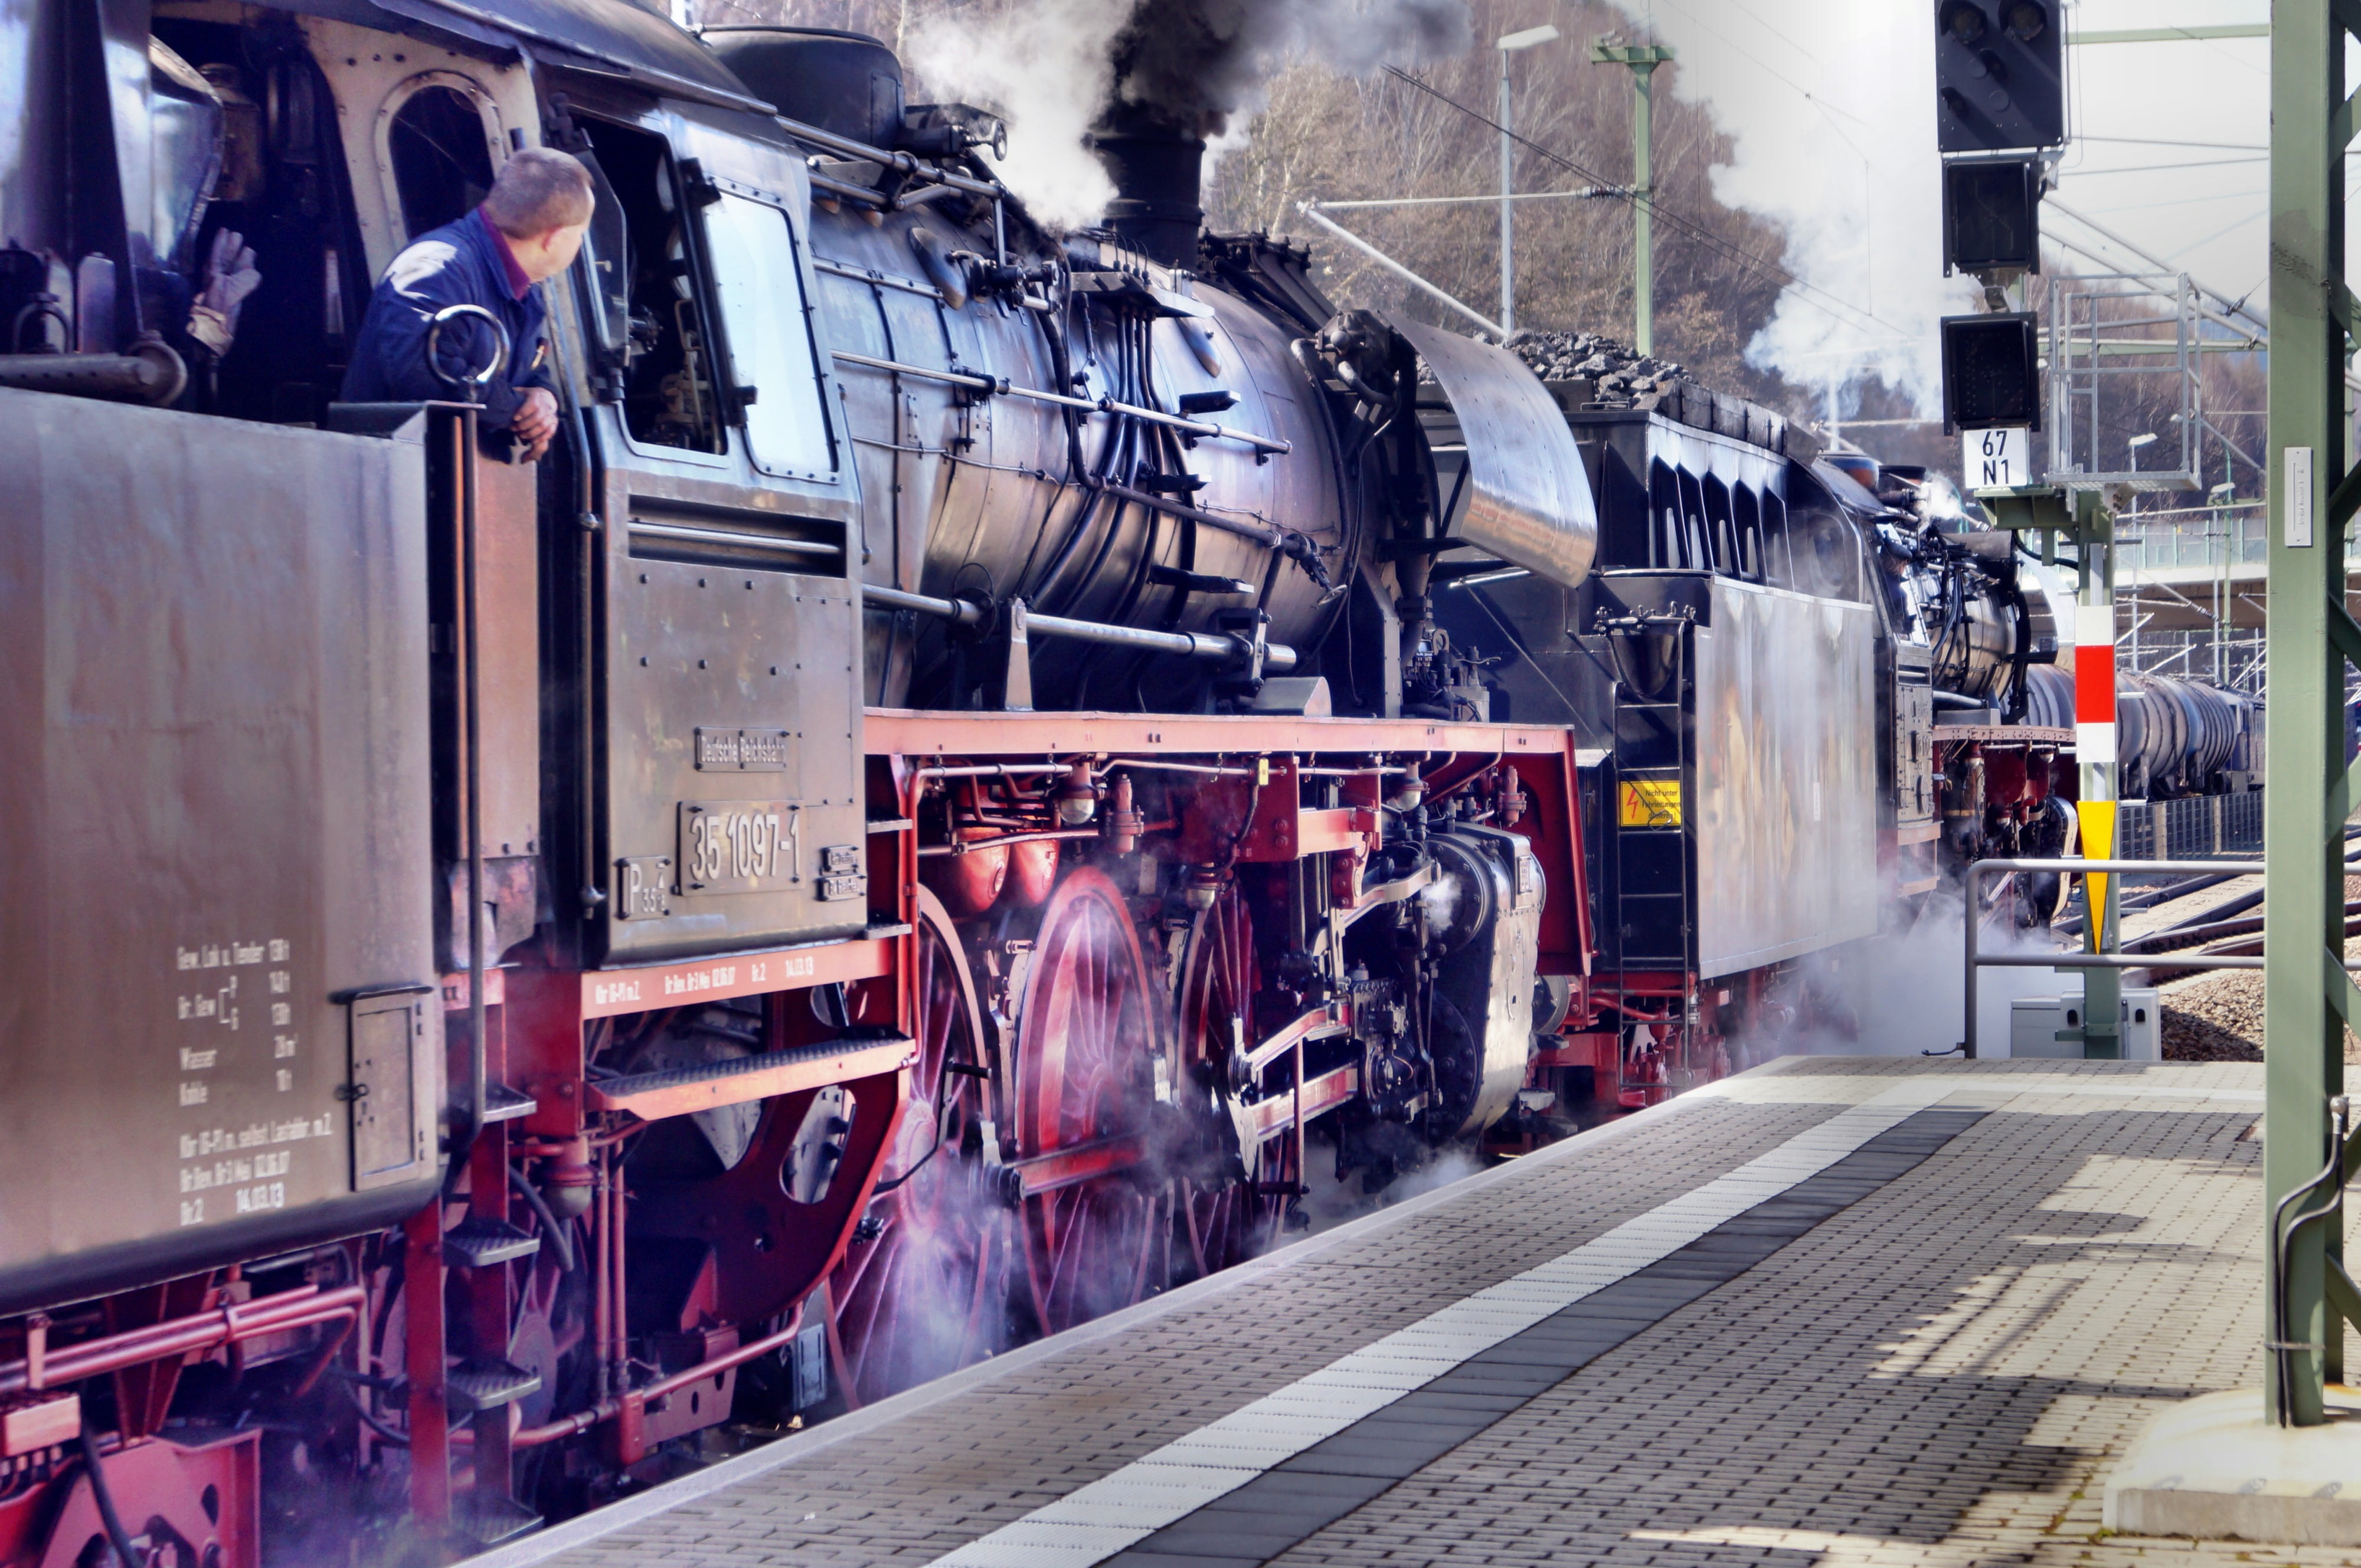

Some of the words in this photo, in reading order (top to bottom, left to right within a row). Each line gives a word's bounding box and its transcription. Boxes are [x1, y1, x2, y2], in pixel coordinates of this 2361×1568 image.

[1982, 430, 2007, 457] 67
[1983, 459, 2009, 486] N1
[701, 735, 738, 762] Deutsche
[740, 736, 786, 763] Reichsbahn
[690, 816, 721, 880] 35
[727, 814, 799, 878] 1097-1
[629, 863, 642, 914] P
